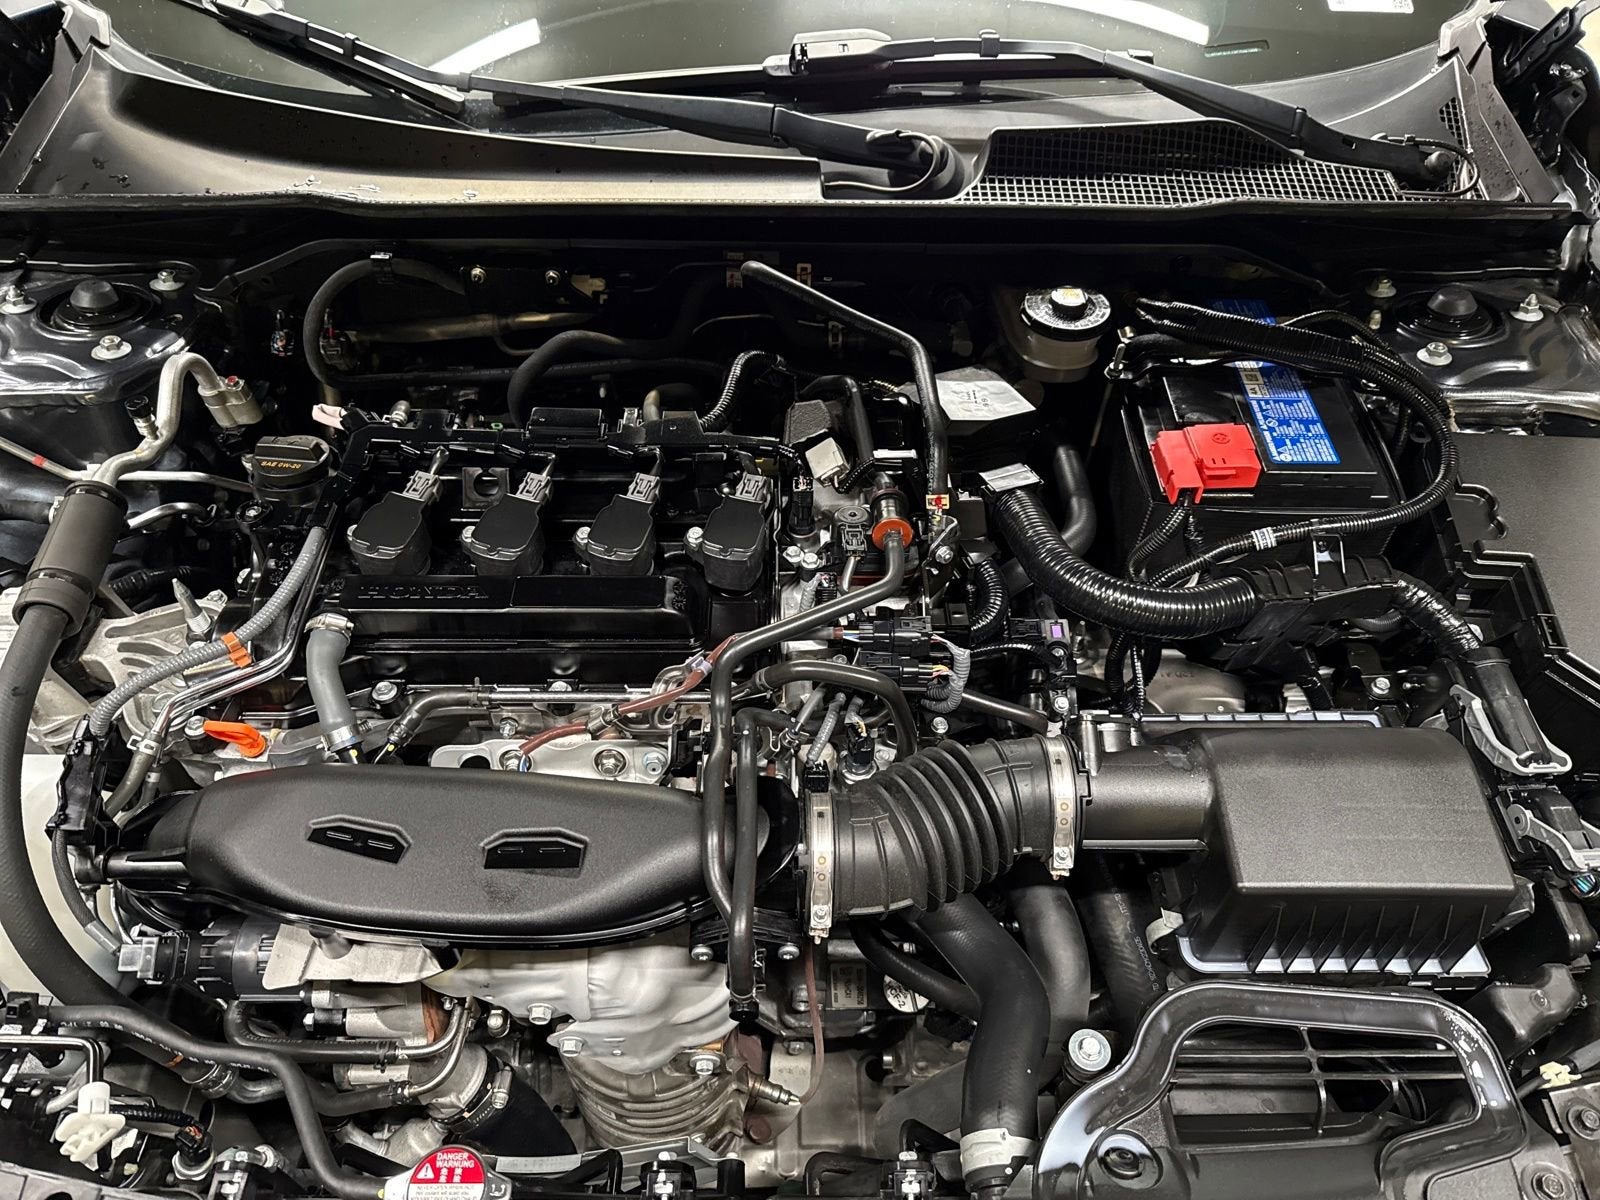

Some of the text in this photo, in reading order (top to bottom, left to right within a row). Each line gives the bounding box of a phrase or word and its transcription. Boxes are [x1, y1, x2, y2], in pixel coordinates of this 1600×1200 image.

[357, 585, 489, 599] HONDA
[886, 980, 906, 1008] HCF-2
[437, 1152, 469, 1160] DANGER
[436, 1160, 475, 1168] WARNUNG
